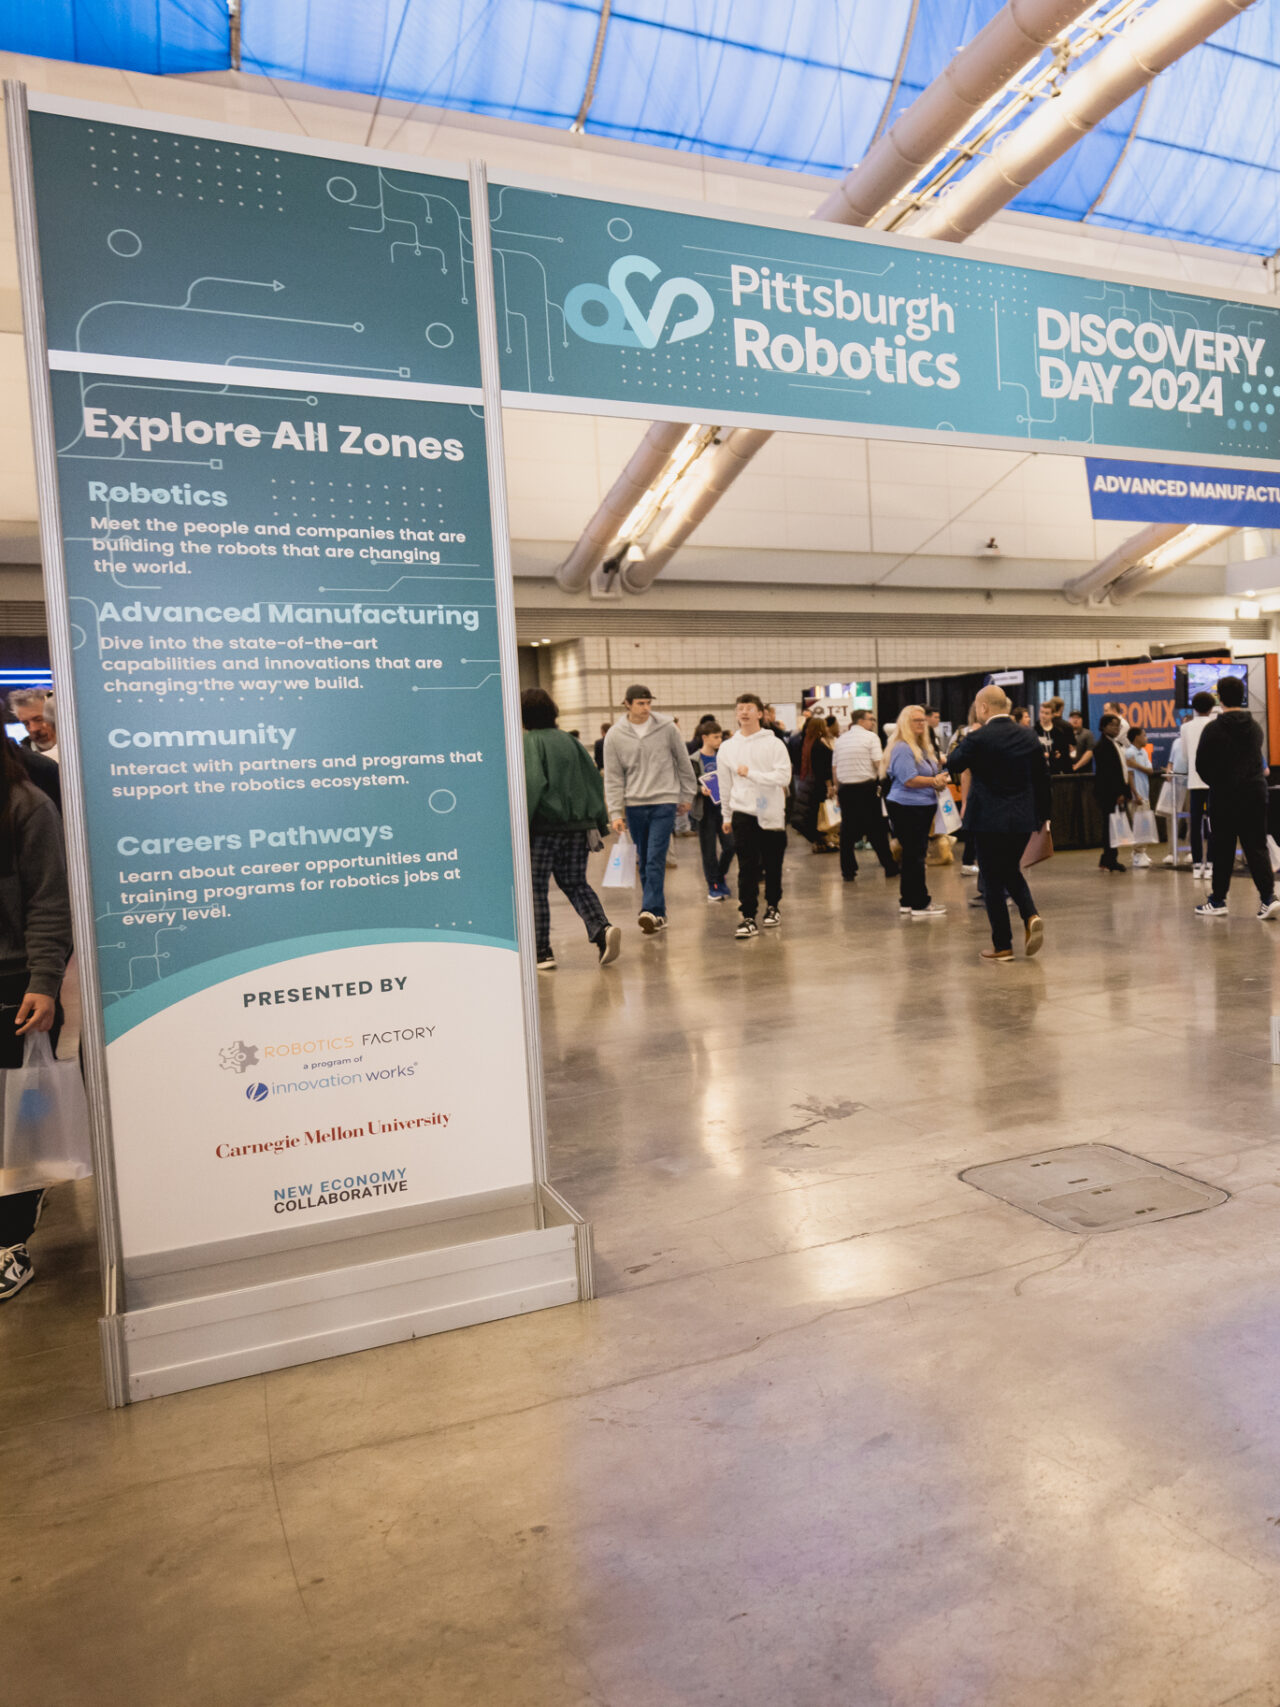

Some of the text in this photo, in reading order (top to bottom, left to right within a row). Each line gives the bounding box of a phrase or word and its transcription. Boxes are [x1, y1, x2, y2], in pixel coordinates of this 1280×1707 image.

[731, 264, 955, 341] Pittsburgh
[733, 317, 960, 390] Robotics
[1037, 307, 1265, 376] DISCOVERY
[1039, 355, 1223, 418] DAY 2024
[84, 407, 464, 461] Explore All Zones
[88, 481, 227, 507] Robotics
[1093, 473, 1187, 499] ADVANCED
[91, 517, 465, 544] Meet the people and companies that are
[93, 538, 440, 564] building the robots that are changing
[94, 559, 191, 575] the world.
[100, 601, 479, 631] Advanced Manufacturing
[101, 635, 377, 650] Dive into the state-of-the-art
[102, 655, 442, 673] capabilities and innovations that are
[104, 676, 364, 695] changing the way we build.
[108, 723, 296, 749] Community
[110, 750, 483, 776] Interact with partners and programs that
[111, 772, 410, 800] support the robotics ecosystem.
[117, 822, 393, 857] Careers Pathways
[120, 847, 458, 885] Learn about career opportunities and
[121, 867, 461, 907] training programs for robotics jobs at
[122, 905, 231, 926] every level.
[243, 977, 408, 1008] PRESENTED BY
[264, 1026, 436, 1058] ROBOTICS FACTORY
[312, 1057, 352, 1070] program
[353, 1055, 363, 1064] of
[272, 1071, 362, 1095] innovation
[216, 1112, 451, 1160] Carnegie Mellon University
[274, 1168, 407, 1200] NEW ECONOMY
[274, 1180, 408, 1213] COLLABORATIVE
